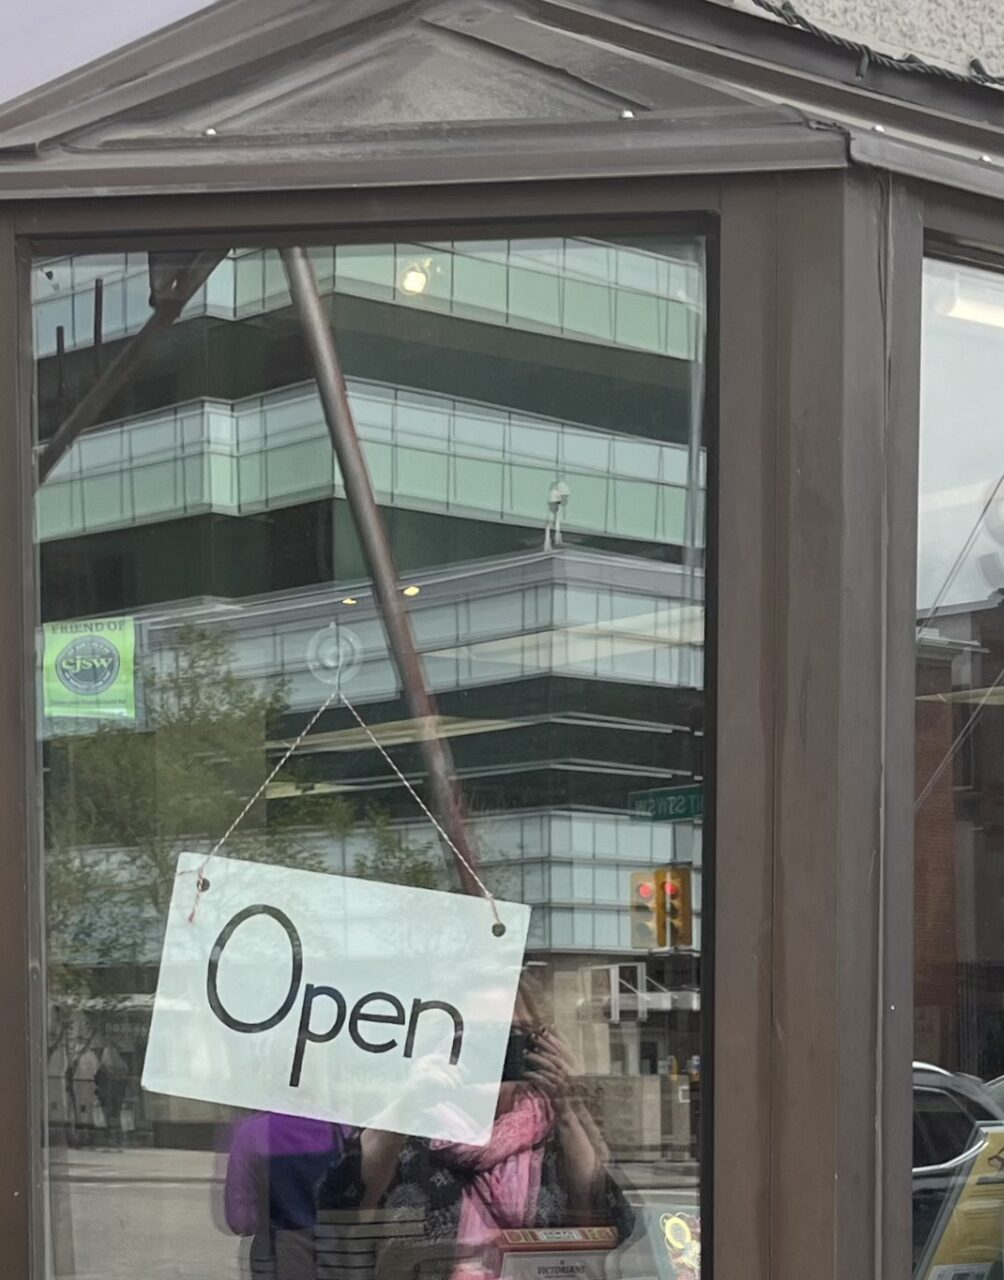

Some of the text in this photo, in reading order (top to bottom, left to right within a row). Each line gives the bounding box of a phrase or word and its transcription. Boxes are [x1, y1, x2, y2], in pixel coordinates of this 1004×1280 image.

[51, 620, 126, 634] FRIEND OF
[206, 904, 465, 1088] Open
